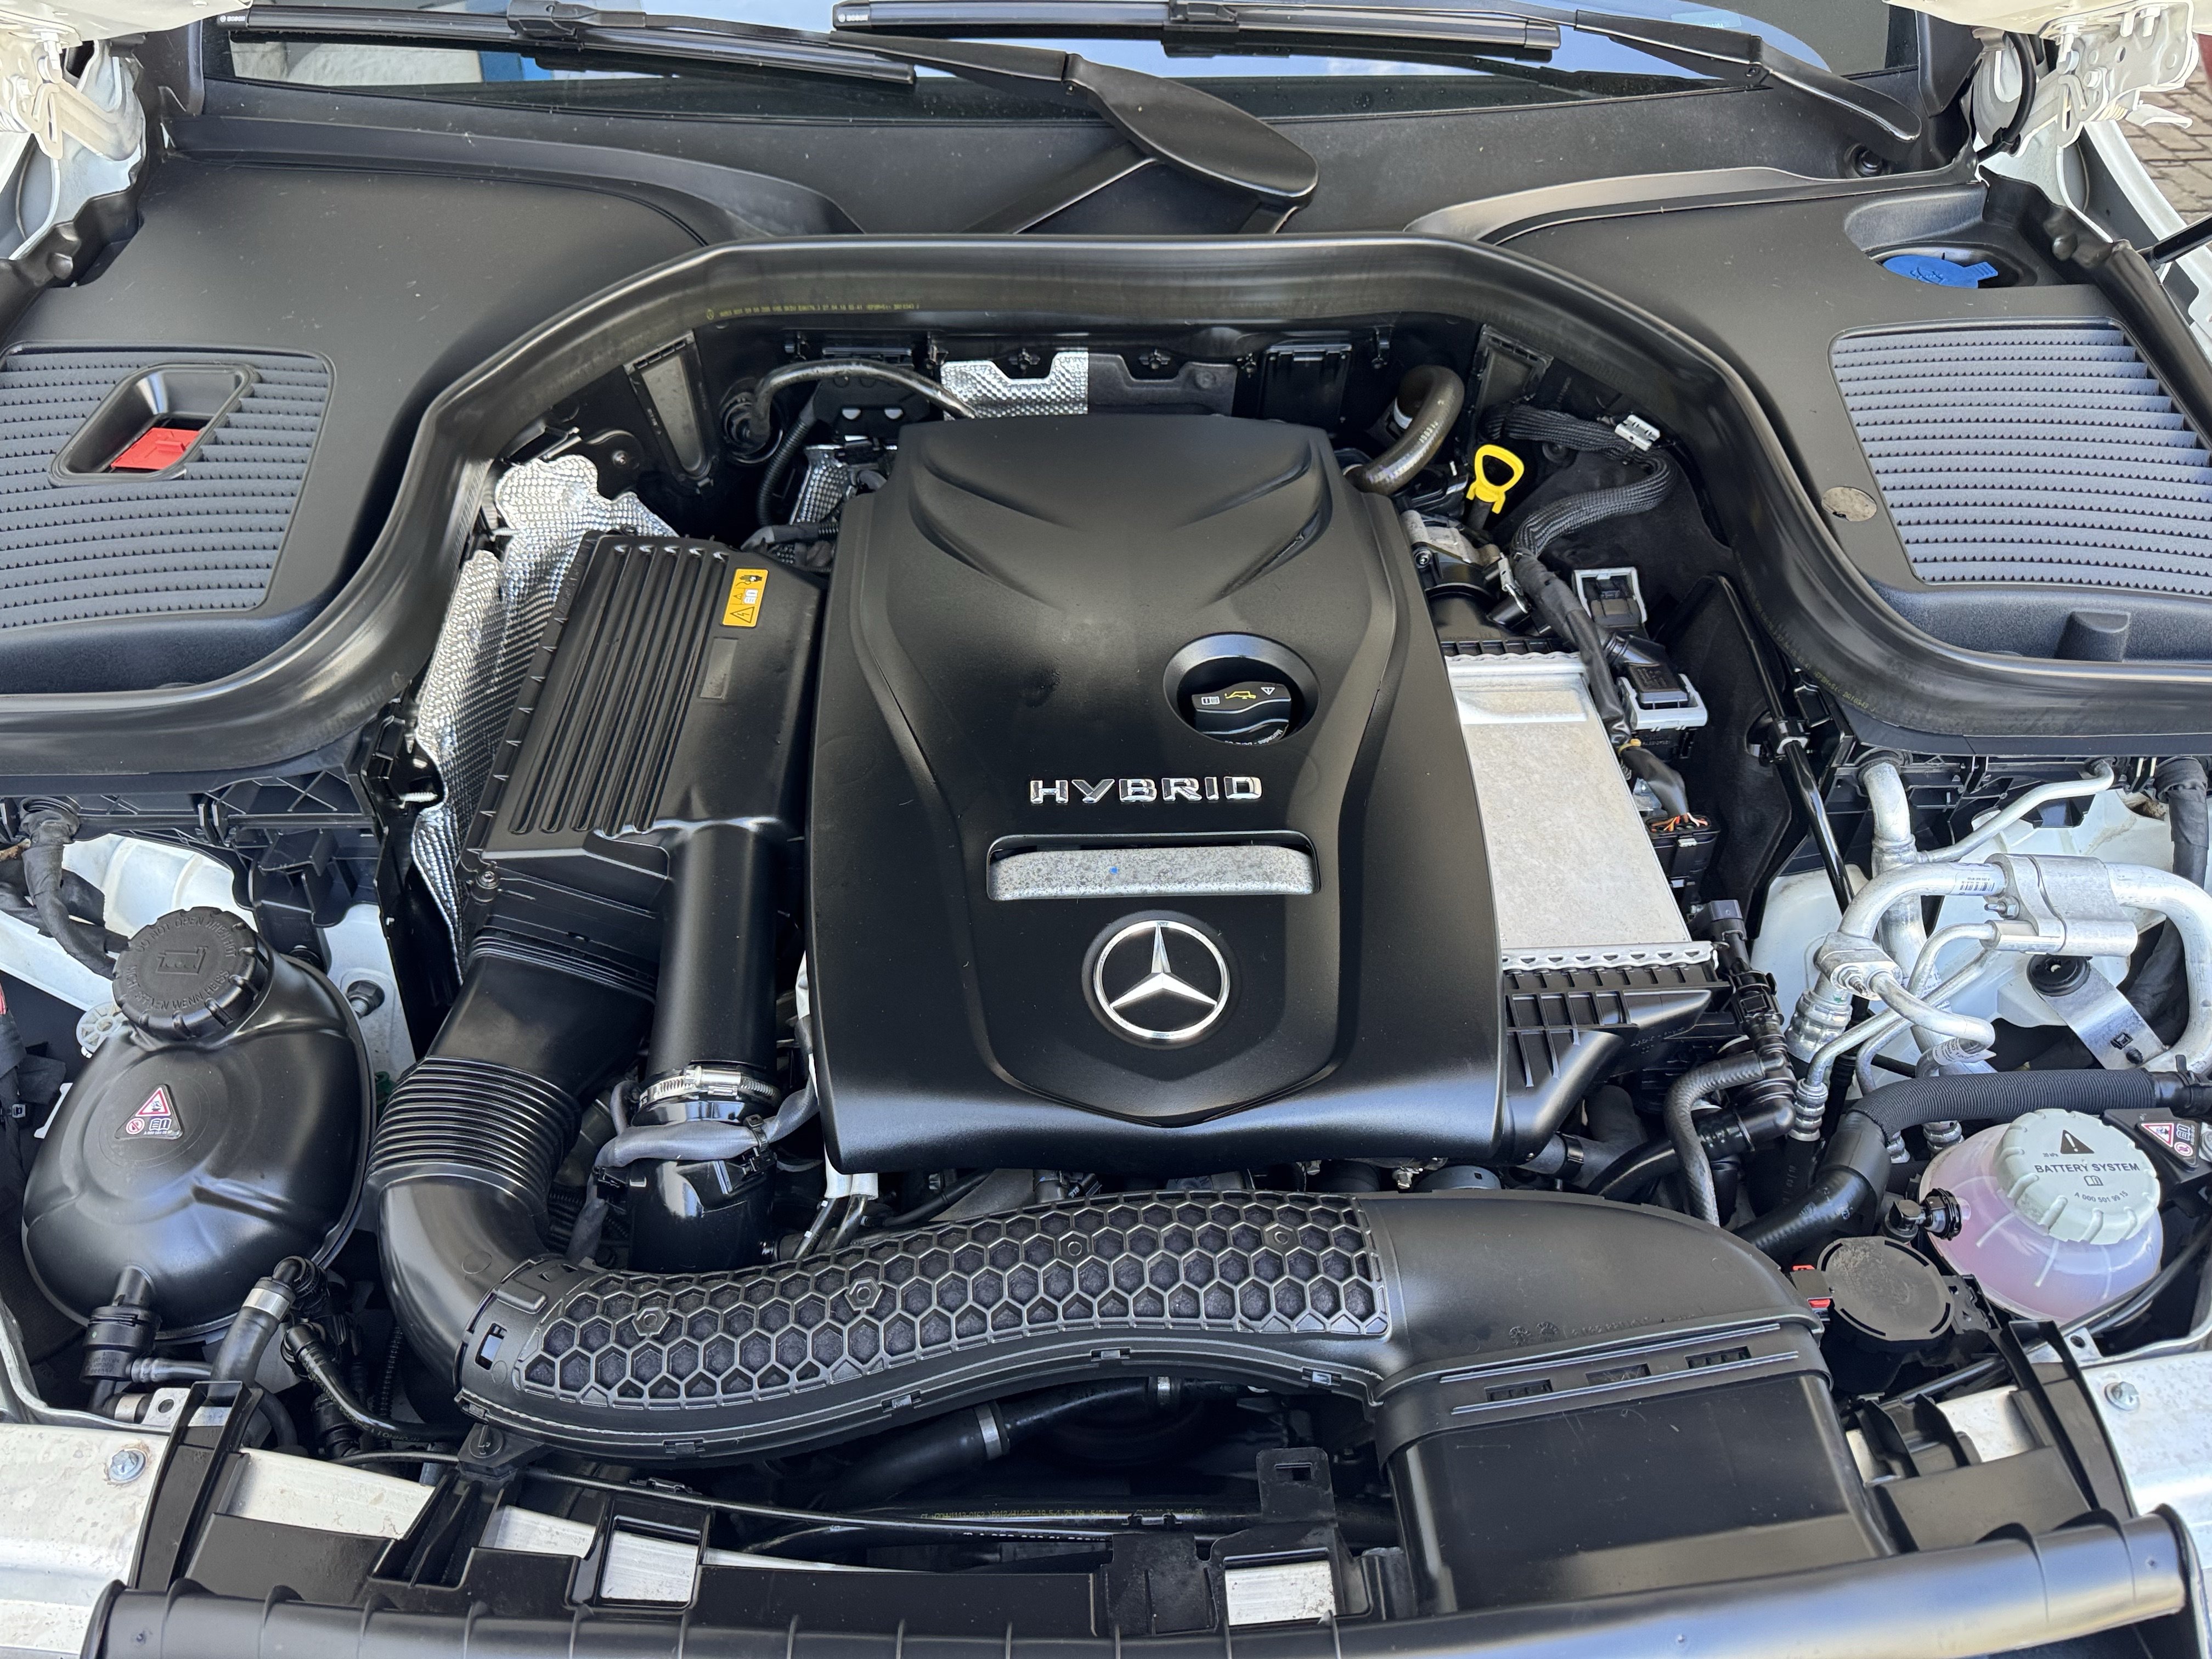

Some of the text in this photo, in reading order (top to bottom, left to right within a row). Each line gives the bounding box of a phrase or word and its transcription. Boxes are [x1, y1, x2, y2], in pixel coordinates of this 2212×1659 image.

[1030, 776, 1262, 804] HYBRID
[136, 939, 150, 953] DO
[151, 922, 171, 940] NOT
[174, 916, 205, 928] OPEN
[223, 939, 237, 958] HOT
[172, 991, 204, 1010] WENN
[204, 969, 230, 996] HEISS
[2034, 1163, 2140, 1173] BATTERY SYSTEM
[2082, 1194, 2096, 1203] 000
